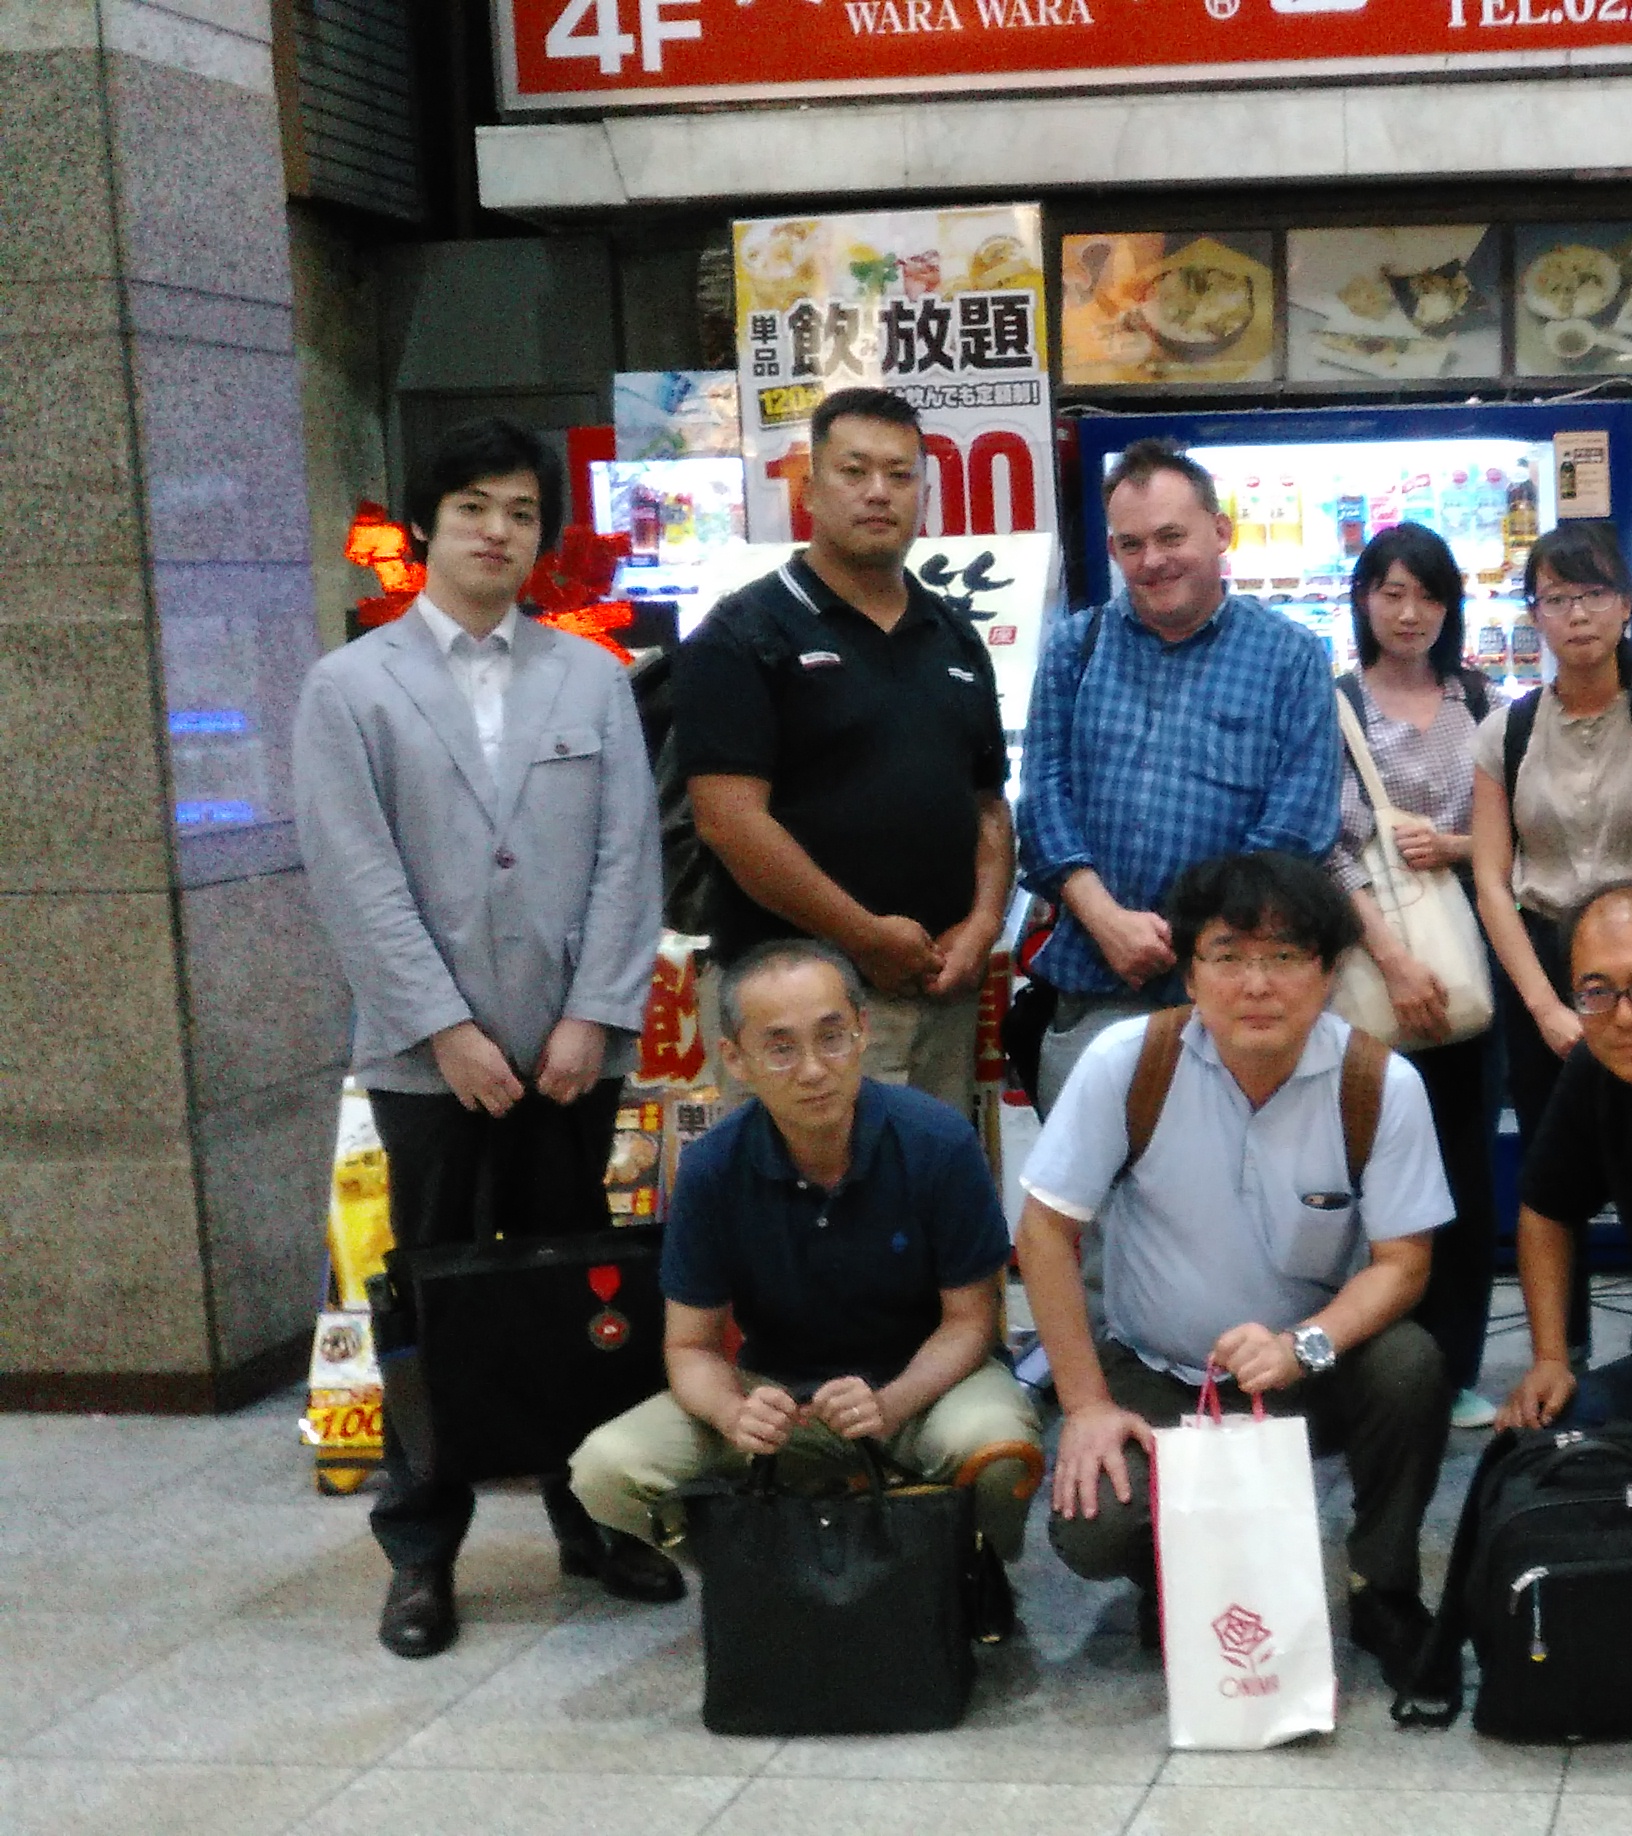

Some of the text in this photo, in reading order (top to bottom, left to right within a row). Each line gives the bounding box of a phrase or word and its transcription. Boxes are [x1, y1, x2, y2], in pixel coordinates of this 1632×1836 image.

[545, 0, 701, 74] 4F
[845, 0, 1095, 35] WARA WARA
[751, 313, 780, 376] 単品
